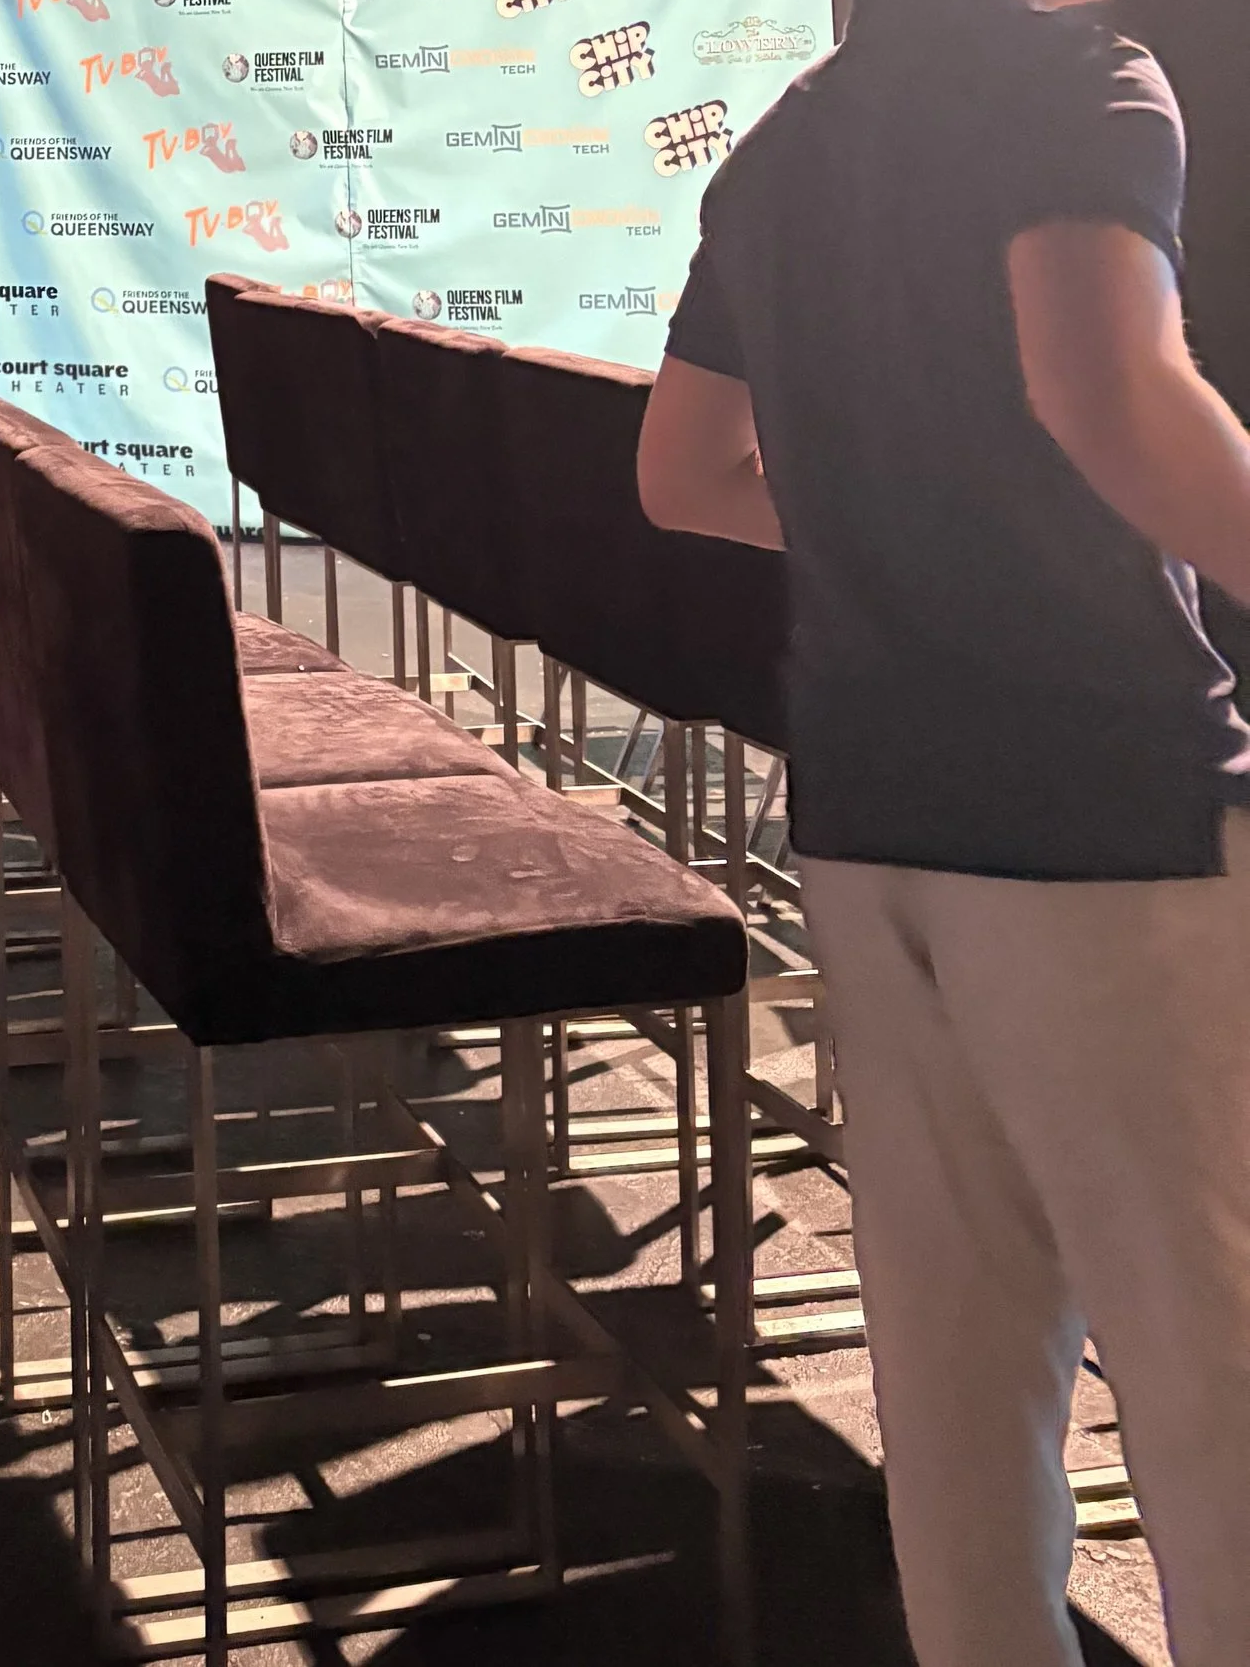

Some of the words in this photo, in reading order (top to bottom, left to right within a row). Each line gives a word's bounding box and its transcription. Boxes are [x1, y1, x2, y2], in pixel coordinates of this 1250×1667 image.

[706, 36, 801, 54] LOWERY
[254, 52, 296, 68] QUEENS
[299, 51, 324, 65] FILM
[375, 45, 450, 74] GEMINI
[254, 67, 304, 83] FESTIVAL
[500, 64, 536, 75] TECH
[10, 138, 46, 146] FRIENDS
[322, 129, 364, 145] QUEENS
[367, 128, 393, 143] FILM
[446, 123, 522, 153] GEMINI
[10, 146, 111, 161] QUEENSWAY
[324, 144, 372, 160] FESTIVAL
[572, 144, 609, 155] TECH
[51, 213, 88, 221] FRIENDS
[89, 213, 102, 221] OF
[367, 209, 411, 224] QUEENS
[413, 209, 440, 223] FILM
[493, 204, 572, 234] GEMINI
[51, 223, 154, 237] QUEENSWAY
[367, 224, 419, 240] FESTIVAL
[626, 226, 661, 236] TECH
[122, 290, 159, 298] FRIENDS
[174, 291, 190, 299] THE
[447, 290, 492, 305] QUEENS
[494, 290, 523, 305] FILM
[579, 286, 657, 316] GEMINI
[448, 306, 502, 321] FESTIVAL
[53, 362, 129, 381] square
[115, 442, 193, 460] square
